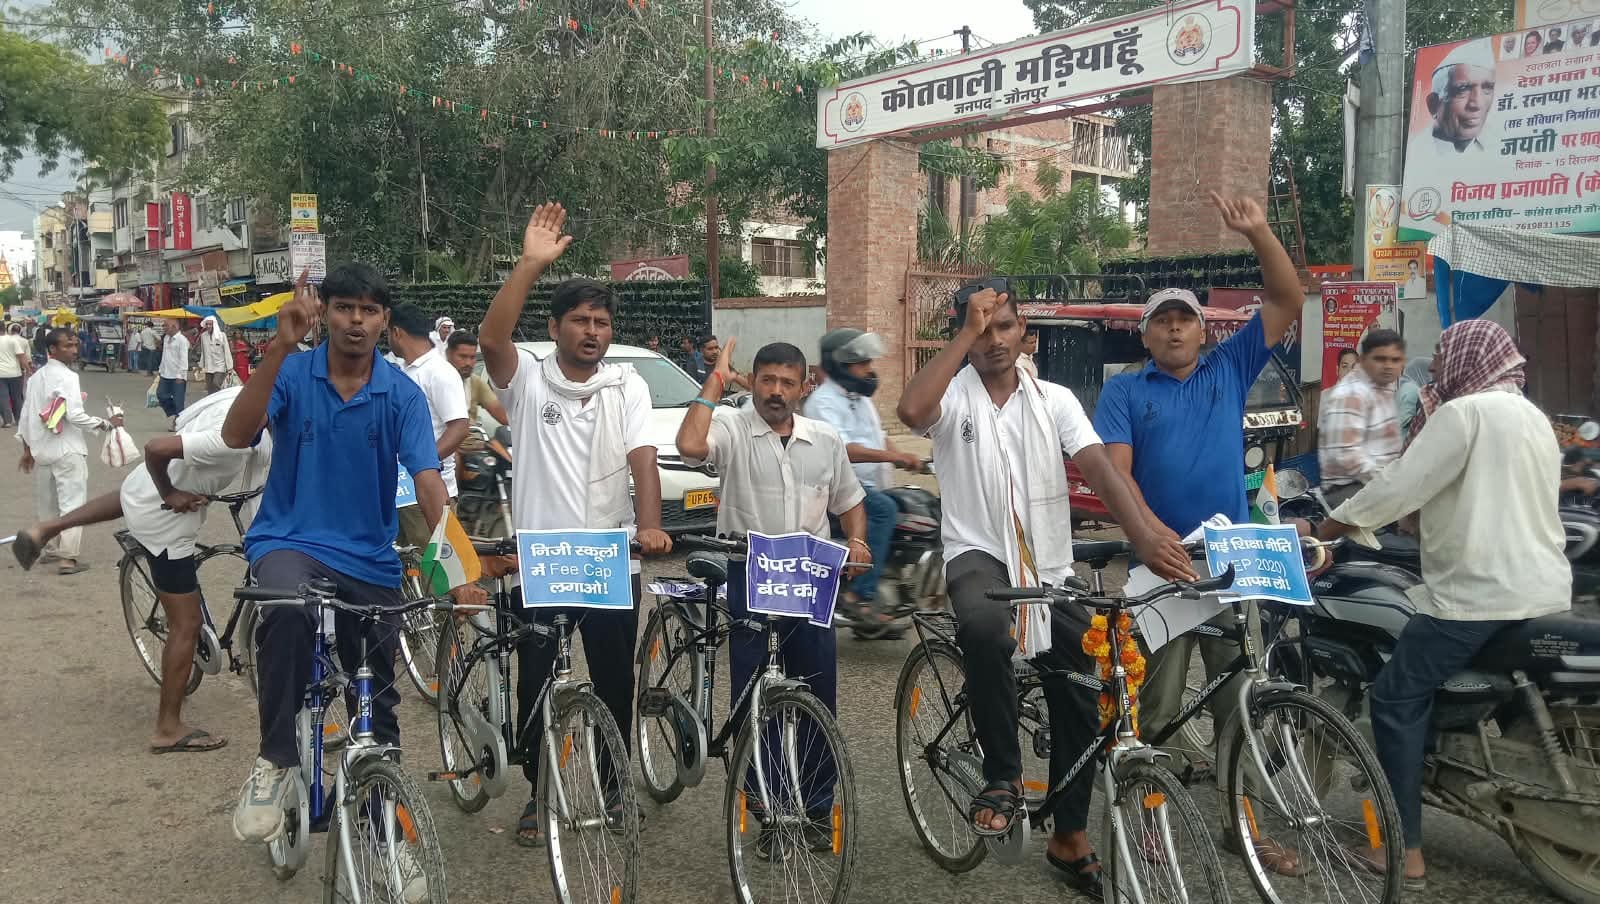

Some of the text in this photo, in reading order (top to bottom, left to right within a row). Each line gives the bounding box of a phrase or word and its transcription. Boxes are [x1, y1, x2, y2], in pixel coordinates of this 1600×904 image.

[881, 26, 1145, 112] कोतवाली मड़ियाहूँ
[1518, 75, 1545, 88] देश
[1547, 69, 1586, 84] भक्त
[954, 97, 992, 114] जनपद
[1004, 87, 1049, 104] जौनपुर
[1498, 93, 1518, 111] डॉ.
[1577, 84, 1600, 100] भर
[1501, 128, 1558, 155] जयंती
[1561, 134, 1578, 147] पर
[1451, 181, 1497, 202] विजय
[1502, 173, 1570, 199] प्रजापति
[1452, 210, 1480, 224] जिला
[530, 541, 619, 562] निजी स्कूलों
[1208, 536, 1292, 553] नई शिक्षा नीति
[530, 563, 612, 579] में Fee Cap
[757, 552, 798, 572] पेपर
[1255, 558, 1287, 578] 2020)
[549, 580, 608, 594] लगाओ!
[757, 579, 789, 597] बंद
